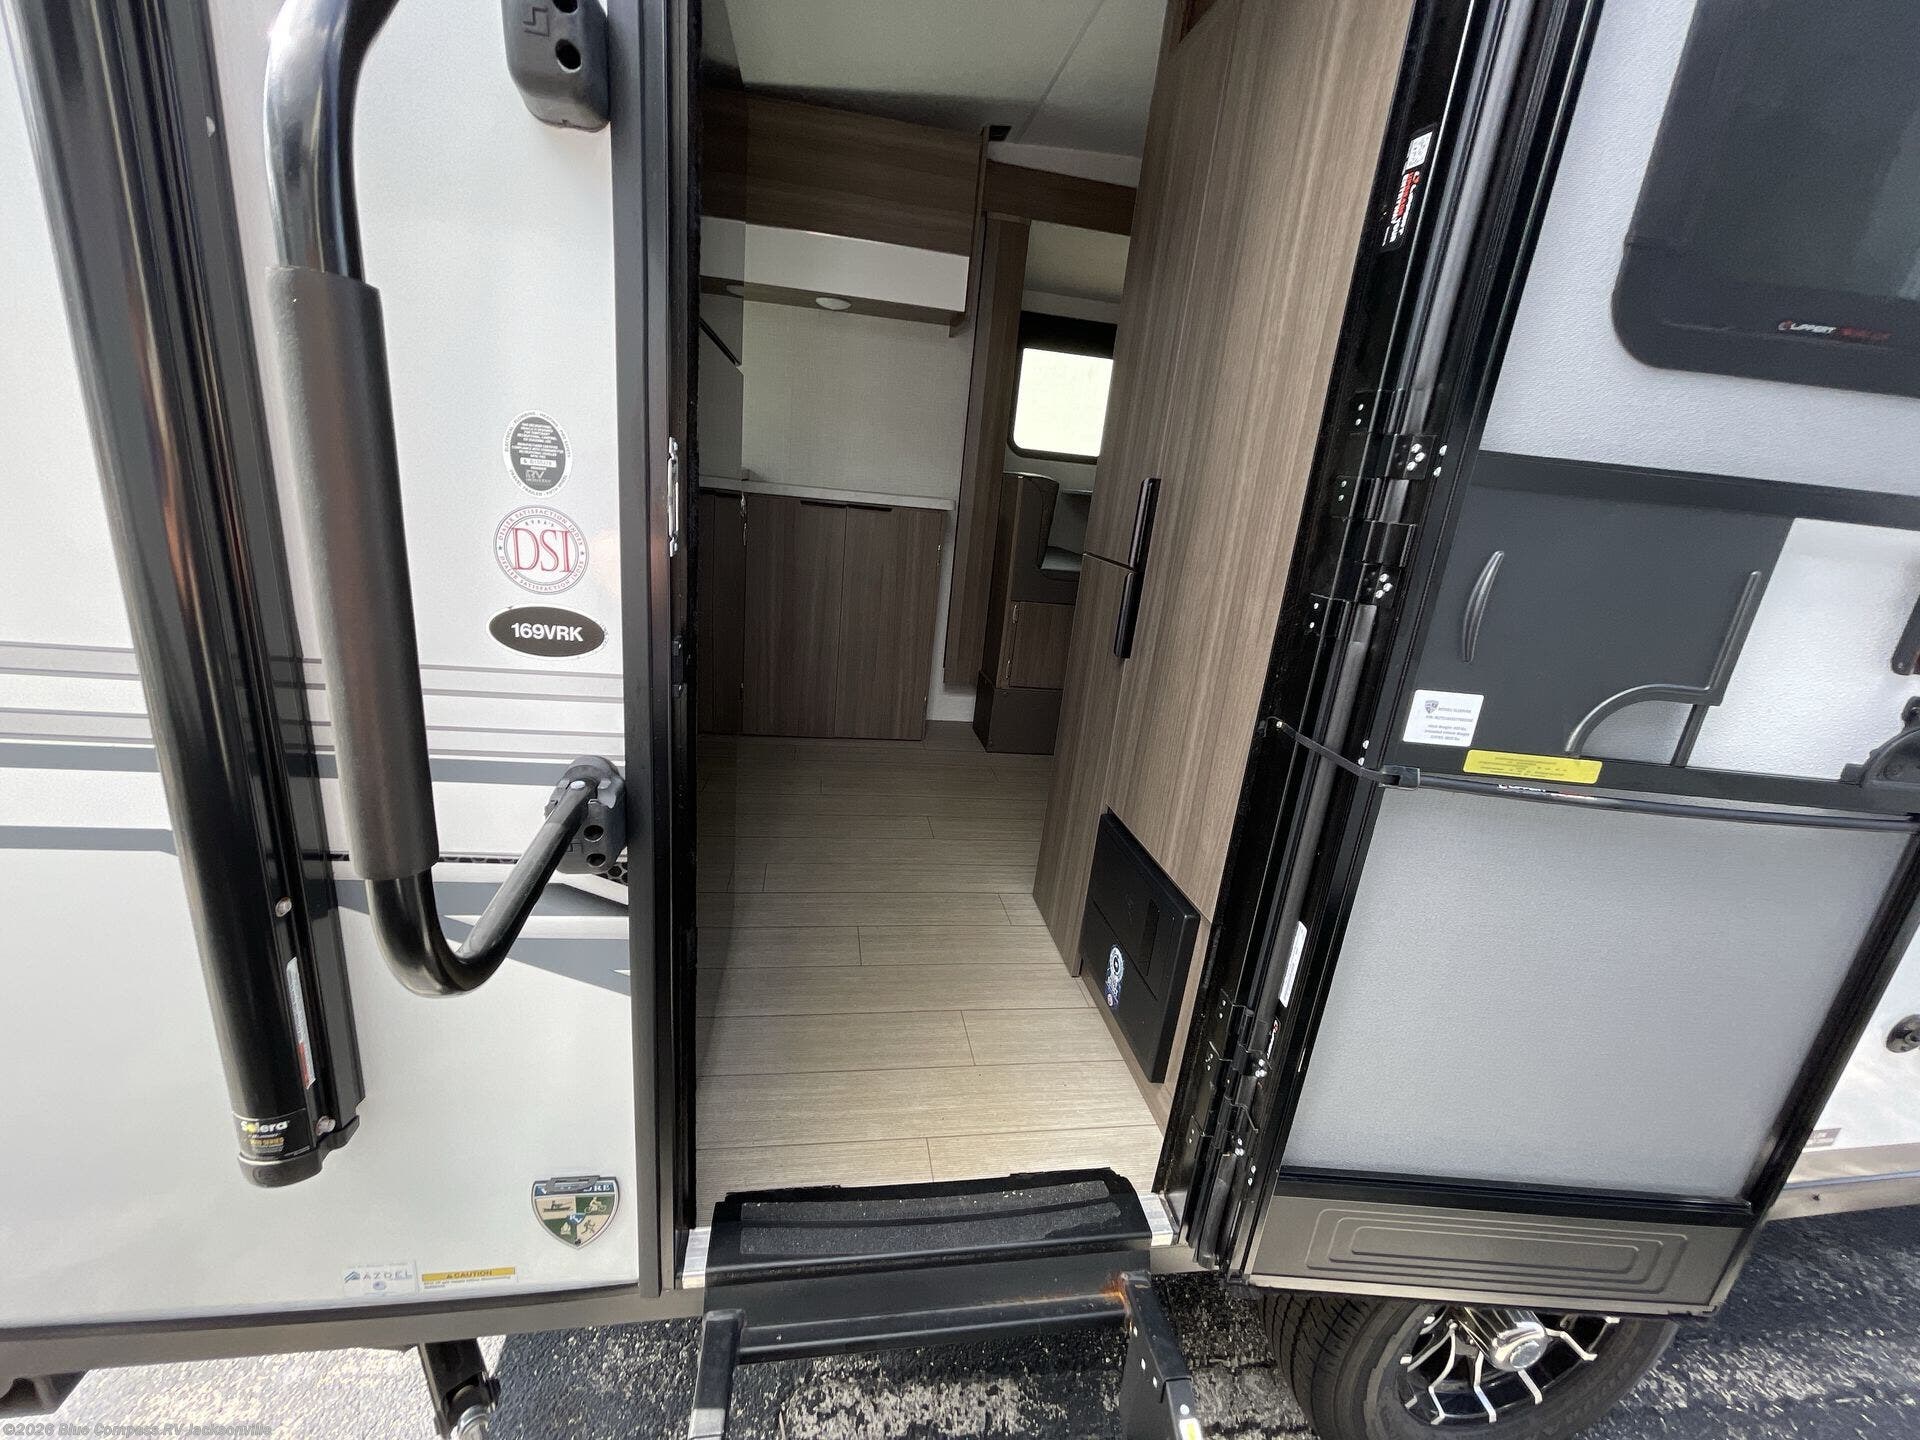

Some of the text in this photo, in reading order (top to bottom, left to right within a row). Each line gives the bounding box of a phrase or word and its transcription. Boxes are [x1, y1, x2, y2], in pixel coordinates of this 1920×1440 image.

[515, 508, 568, 524] SATISFACTION
[568, 524, 585, 546] INDEX
[512, 527, 572, 573] DSI
[519, 579, 570, 592] SATISFACTION
[510, 622, 584, 642] 169VRK
[240, 1120, 288, 1133] Solera
[453, 1269, 493, 1280] CAUTION
